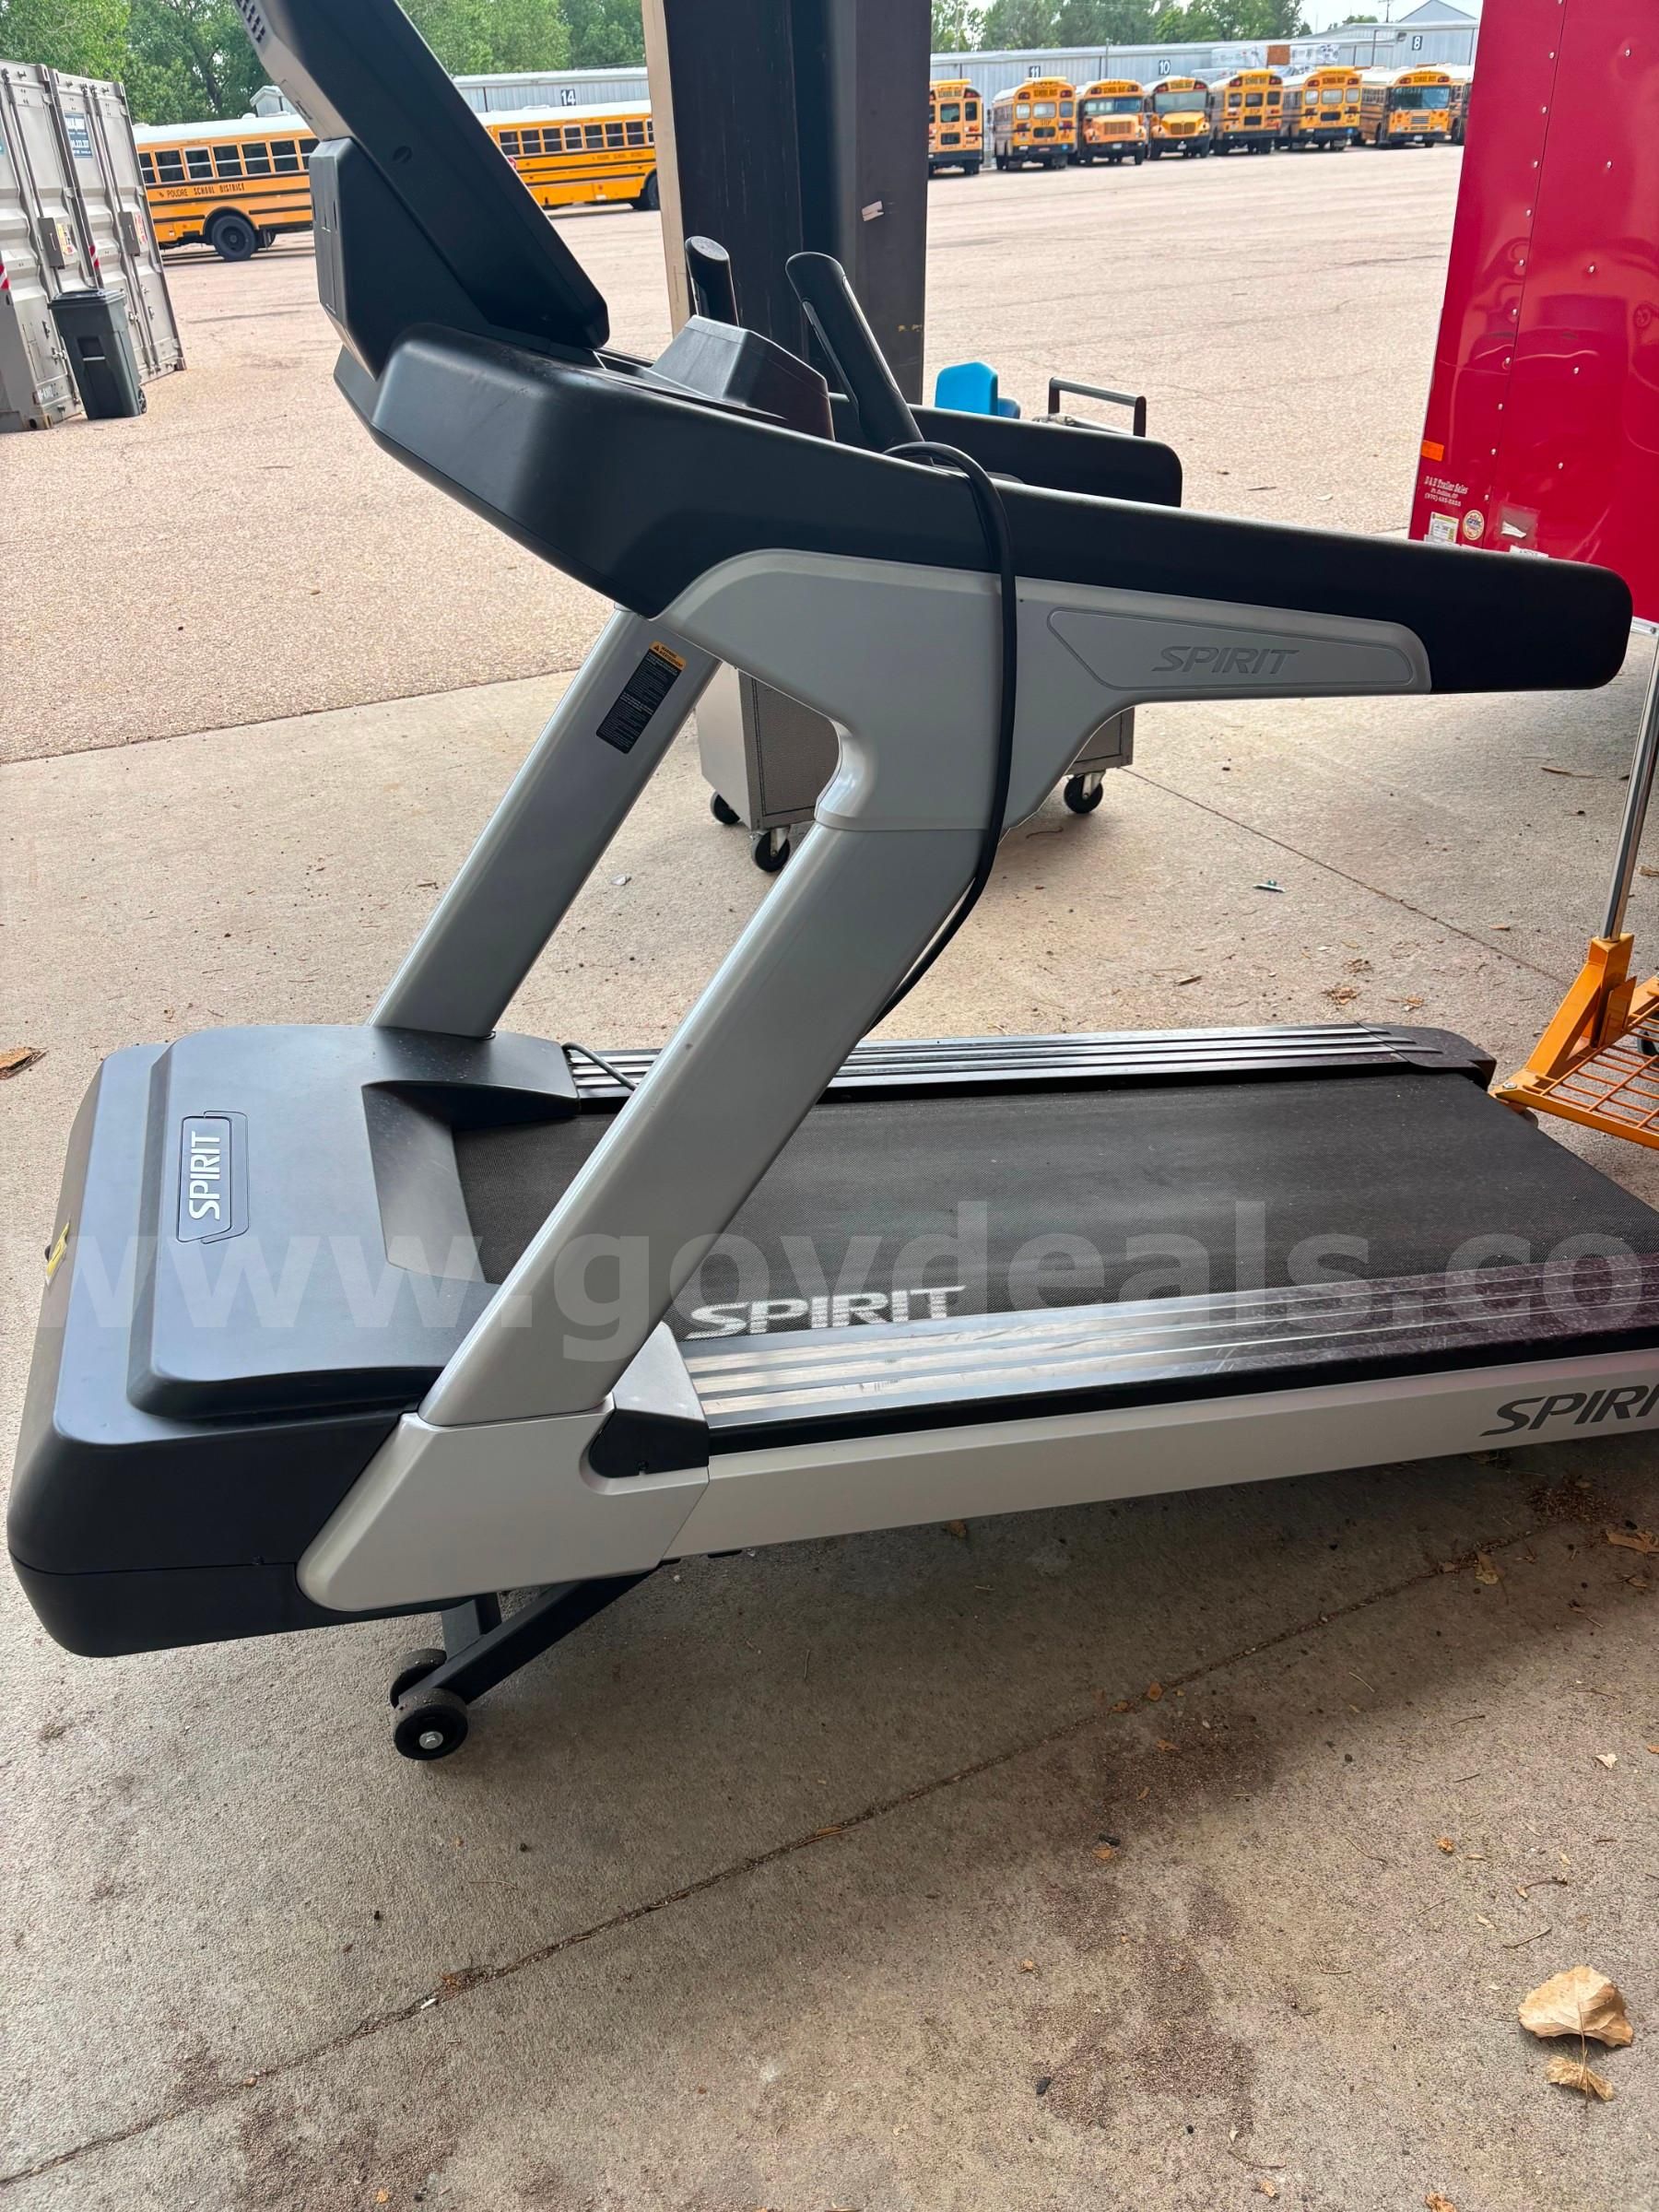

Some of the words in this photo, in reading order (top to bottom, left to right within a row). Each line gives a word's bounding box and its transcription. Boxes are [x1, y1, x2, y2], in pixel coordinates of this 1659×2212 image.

[1413, 36, 1422, 50] 8
[1030, 66, 1041, 77] 11
[1159, 60, 1171, 75] 10
[561, 89, 576, 106] 14
[167, 188, 188, 198] POUDRE
[194, 185, 216, 195] SCHOOL
[219, 182, 245, 193] DISTRICT
[1151, 646, 1300, 675] SPIRIT
[189, 1130, 221, 1221] SPIRIT
[685, 1286, 967, 1339] SPIRIT
